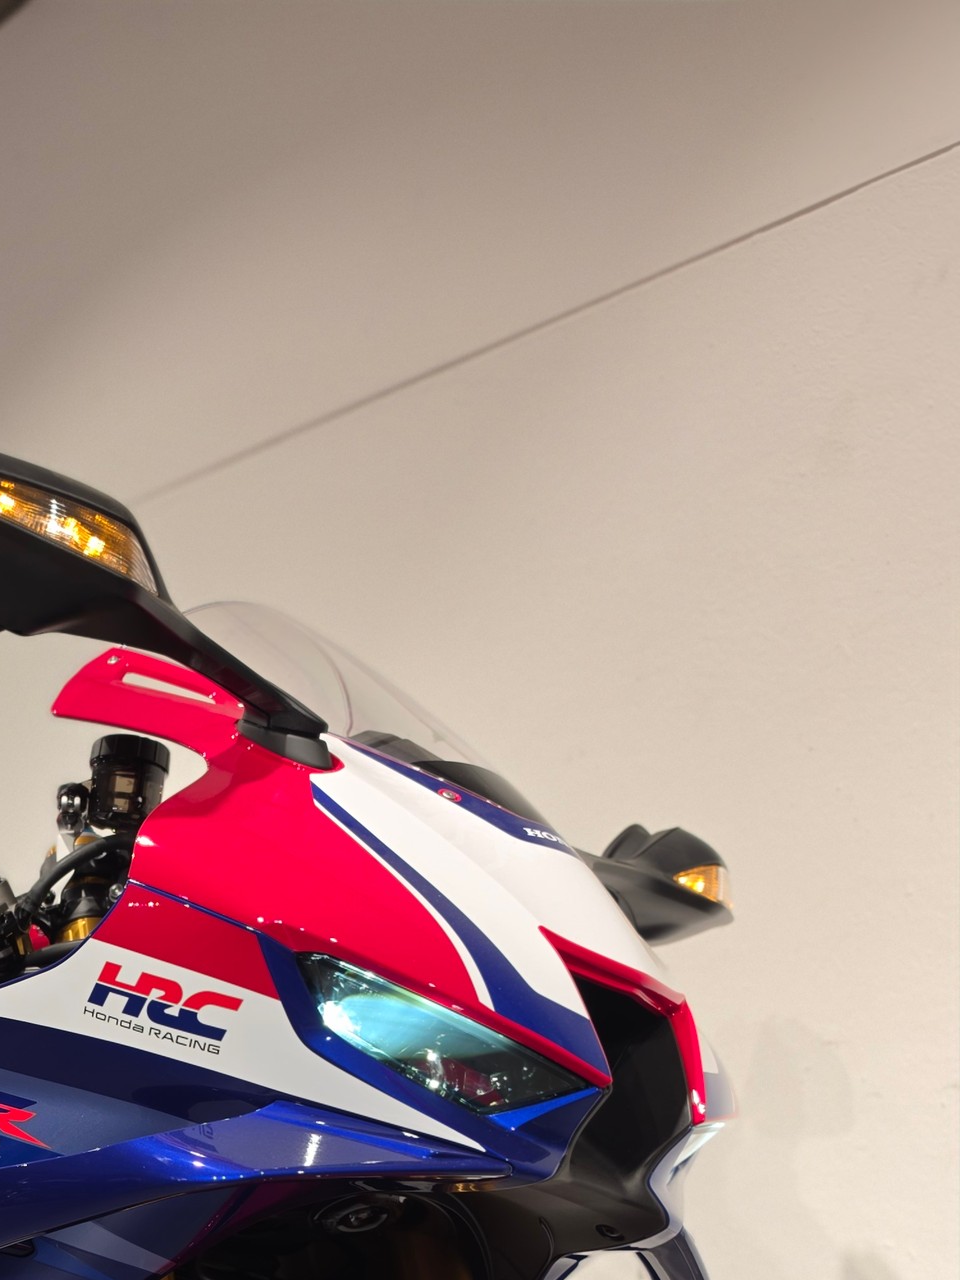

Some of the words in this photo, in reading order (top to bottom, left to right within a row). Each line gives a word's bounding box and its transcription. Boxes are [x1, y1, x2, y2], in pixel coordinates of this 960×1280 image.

[83, 1006, 144, 1033] Honda
[148, 1027, 220, 1055] RACING
[87, 961, 244, 1041] HRC
